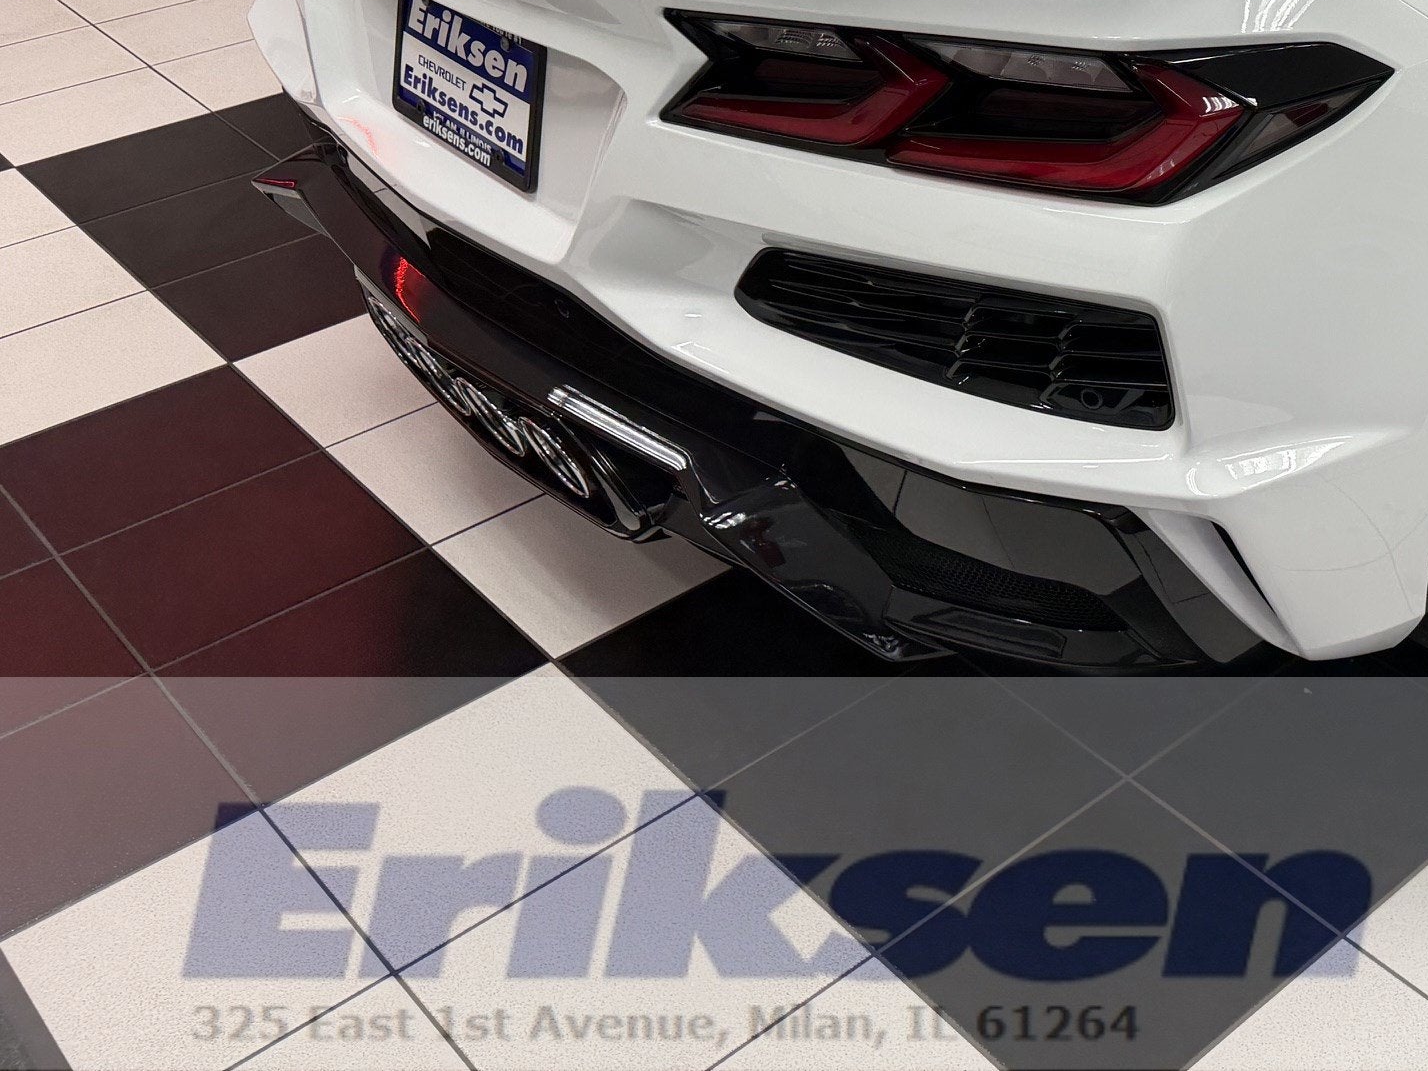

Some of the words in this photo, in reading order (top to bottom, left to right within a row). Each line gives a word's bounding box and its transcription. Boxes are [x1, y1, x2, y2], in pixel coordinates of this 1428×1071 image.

[418, 53, 467, 92] CHEVROLET
[403, 63, 525, 155] Eriksens.com
[422, 114, 492, 168] eriksens.com
